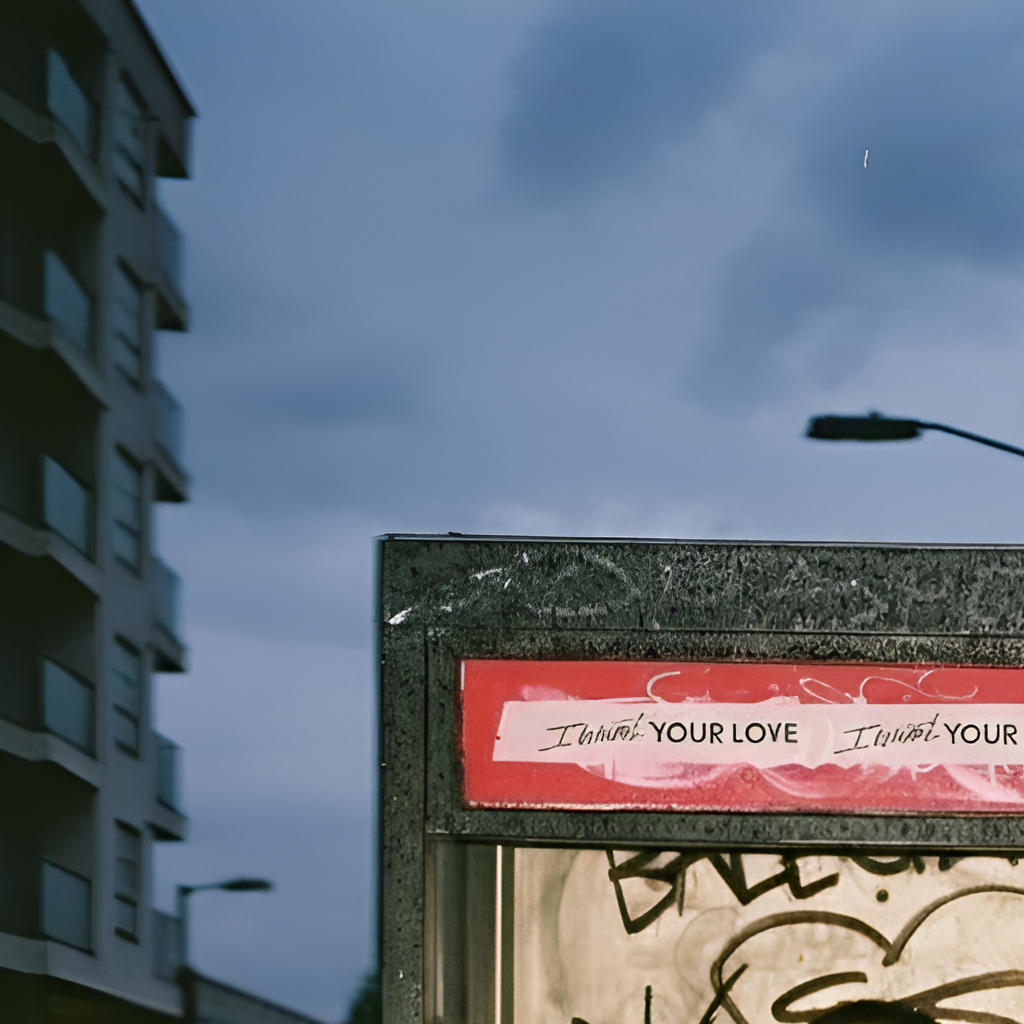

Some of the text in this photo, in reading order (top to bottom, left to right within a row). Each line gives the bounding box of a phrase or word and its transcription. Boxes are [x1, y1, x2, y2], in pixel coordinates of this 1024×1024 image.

[648, 721, 724, 744] YOUR
[732, 722, 798, 745] LOVE
[943, 722, 1018, 746] YOUR
